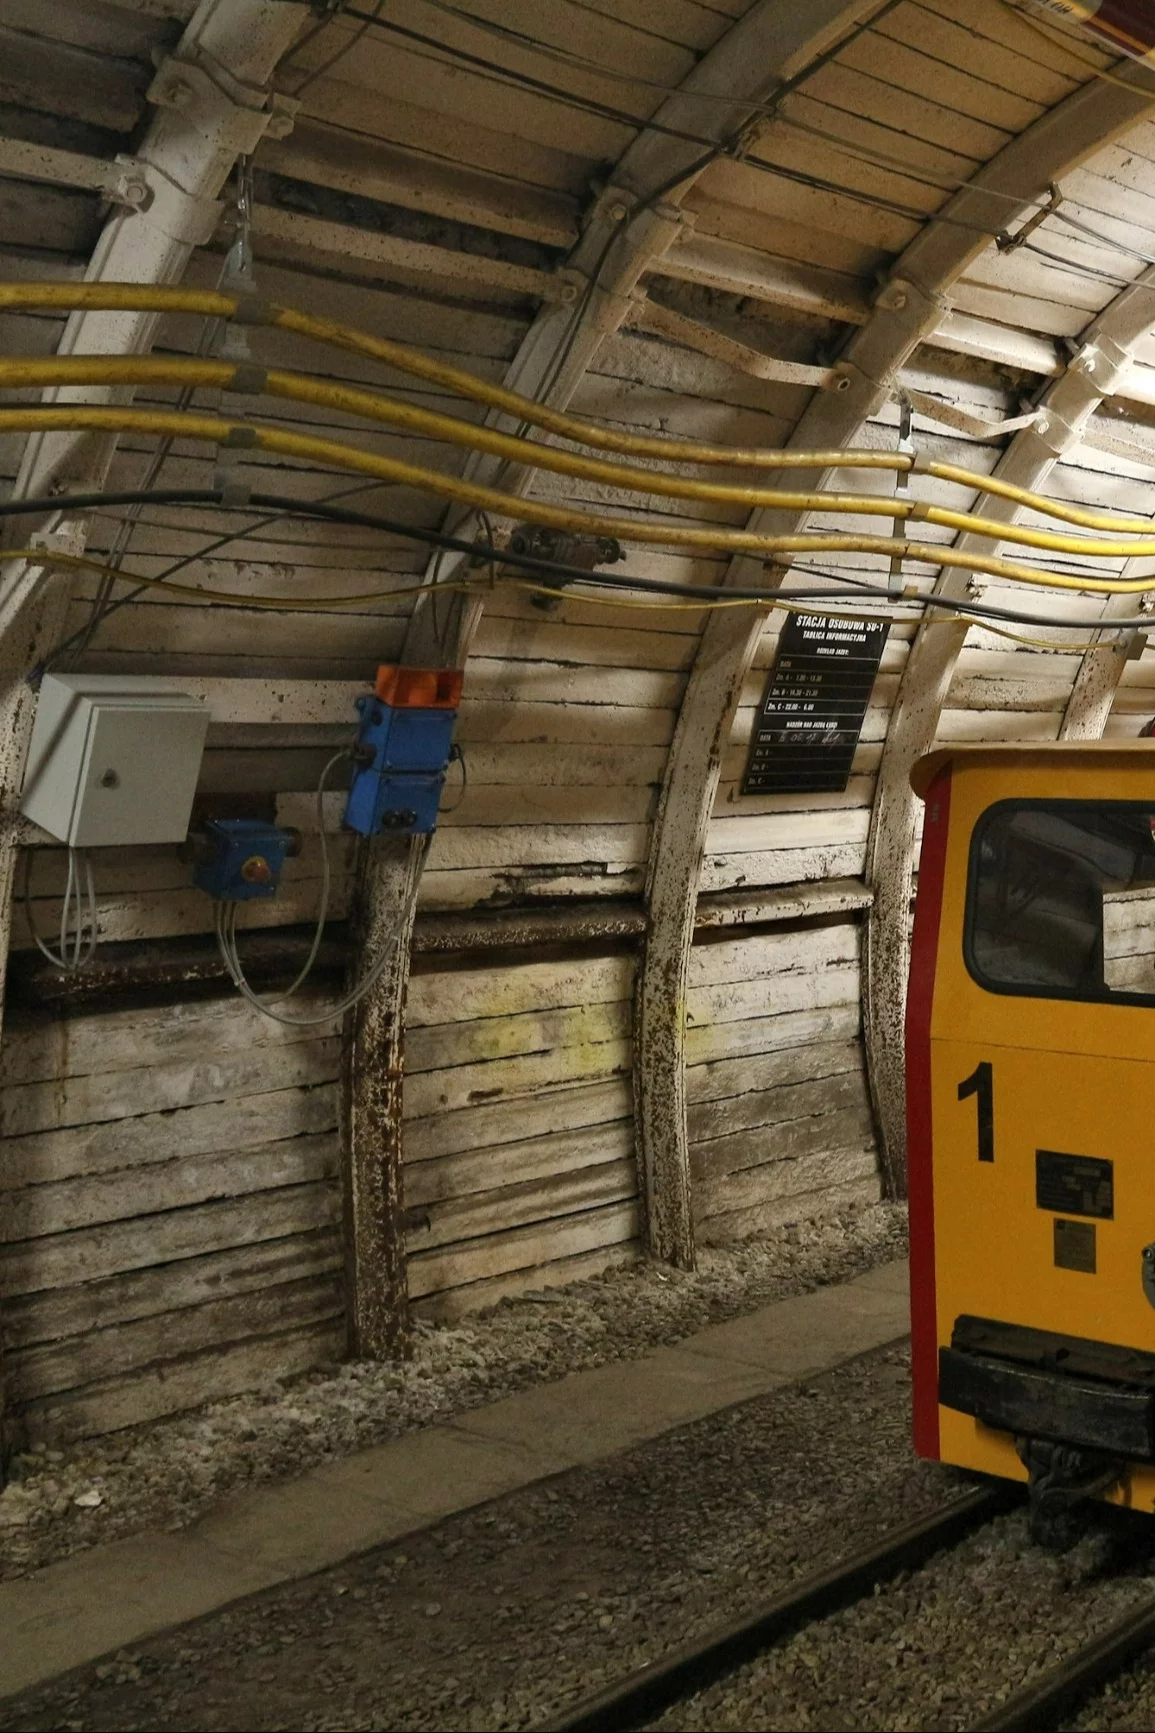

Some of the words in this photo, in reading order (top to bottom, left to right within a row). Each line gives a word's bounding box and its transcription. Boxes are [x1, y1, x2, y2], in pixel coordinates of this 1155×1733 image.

[796, 615, 826, 628] STACJA
[803, 630, 825, 640] TABLICA
[826, 632, 867, 642] INFORMACYJNA
[957, 1061, 994, 1163] 1
